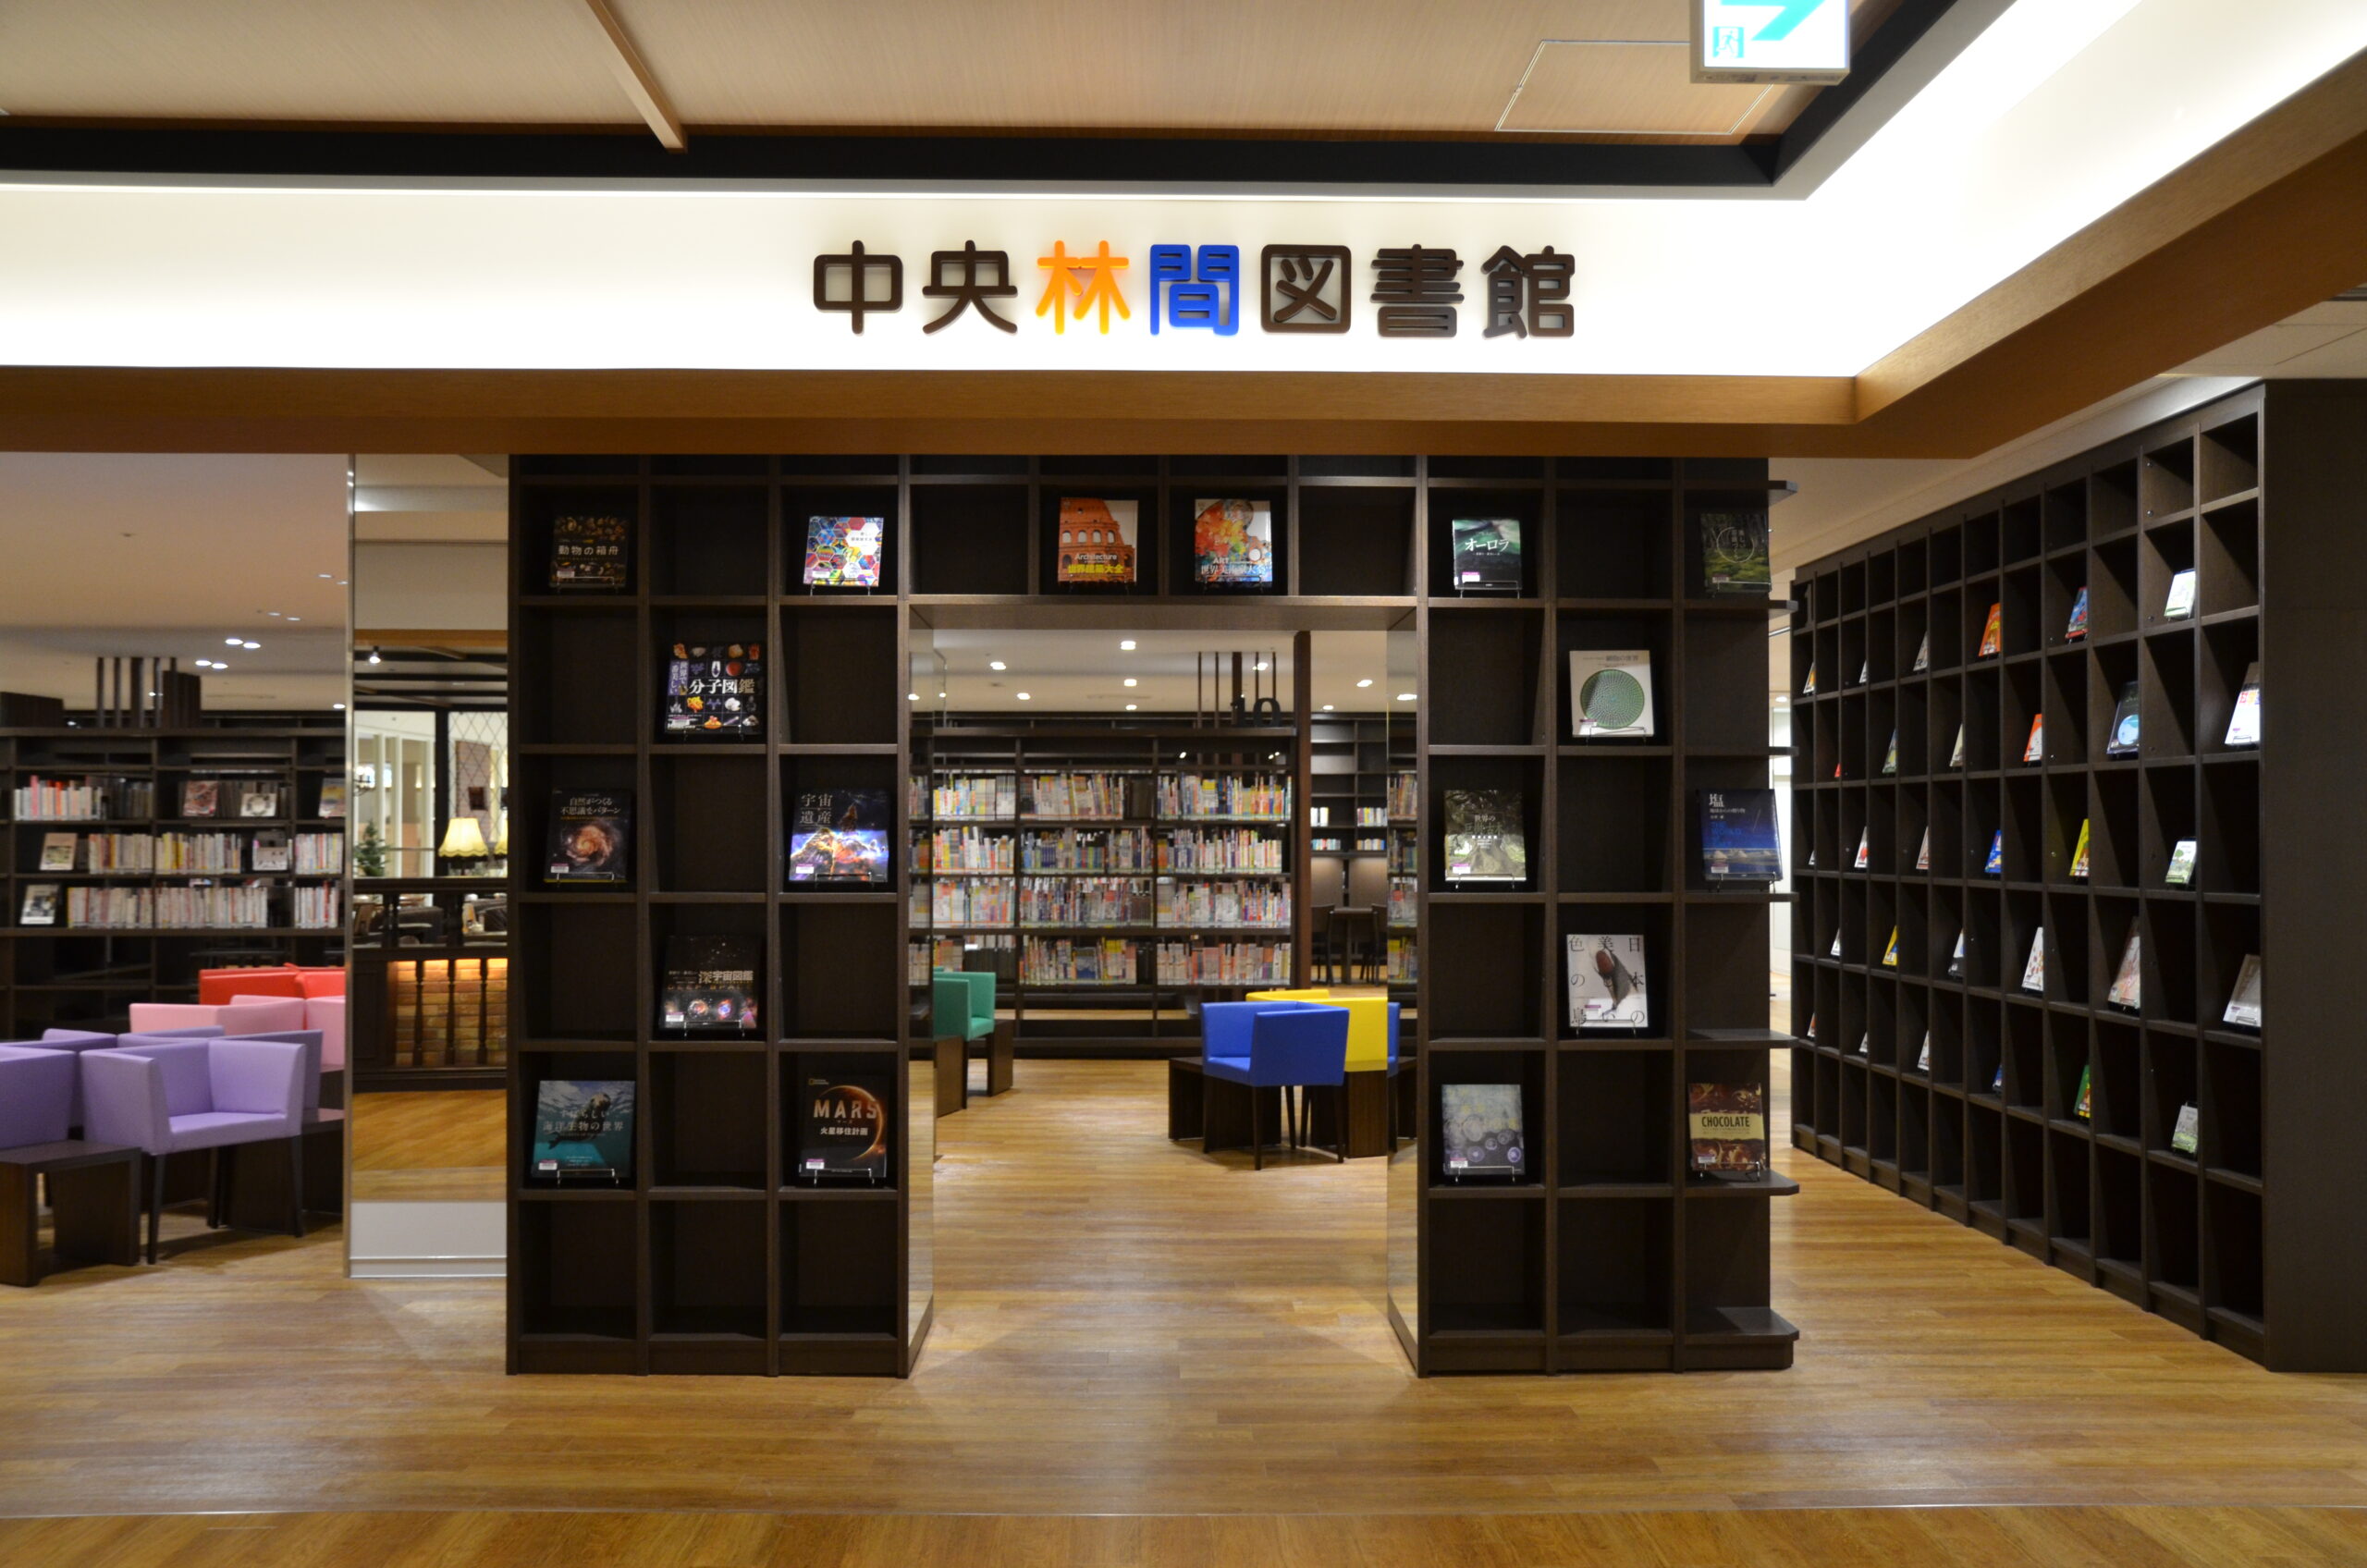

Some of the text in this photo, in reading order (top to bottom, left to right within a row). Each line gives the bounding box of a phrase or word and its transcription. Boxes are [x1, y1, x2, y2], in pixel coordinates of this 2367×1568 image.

[813, 239, 1576, 338] 中央林間図書館
[1465, 538, 1509, 552] オーロラ
[689, 679, 755, 694] 分子図鑑
[1231, 697, 1281, 728] 10
[801, 794, 833, 807] 宇宙
[800, 811, 832, 825] 遺産
[814, 1099, 877, 1119] MARS
[1701, 1116, 1751, 1128] CHOCOLATE
